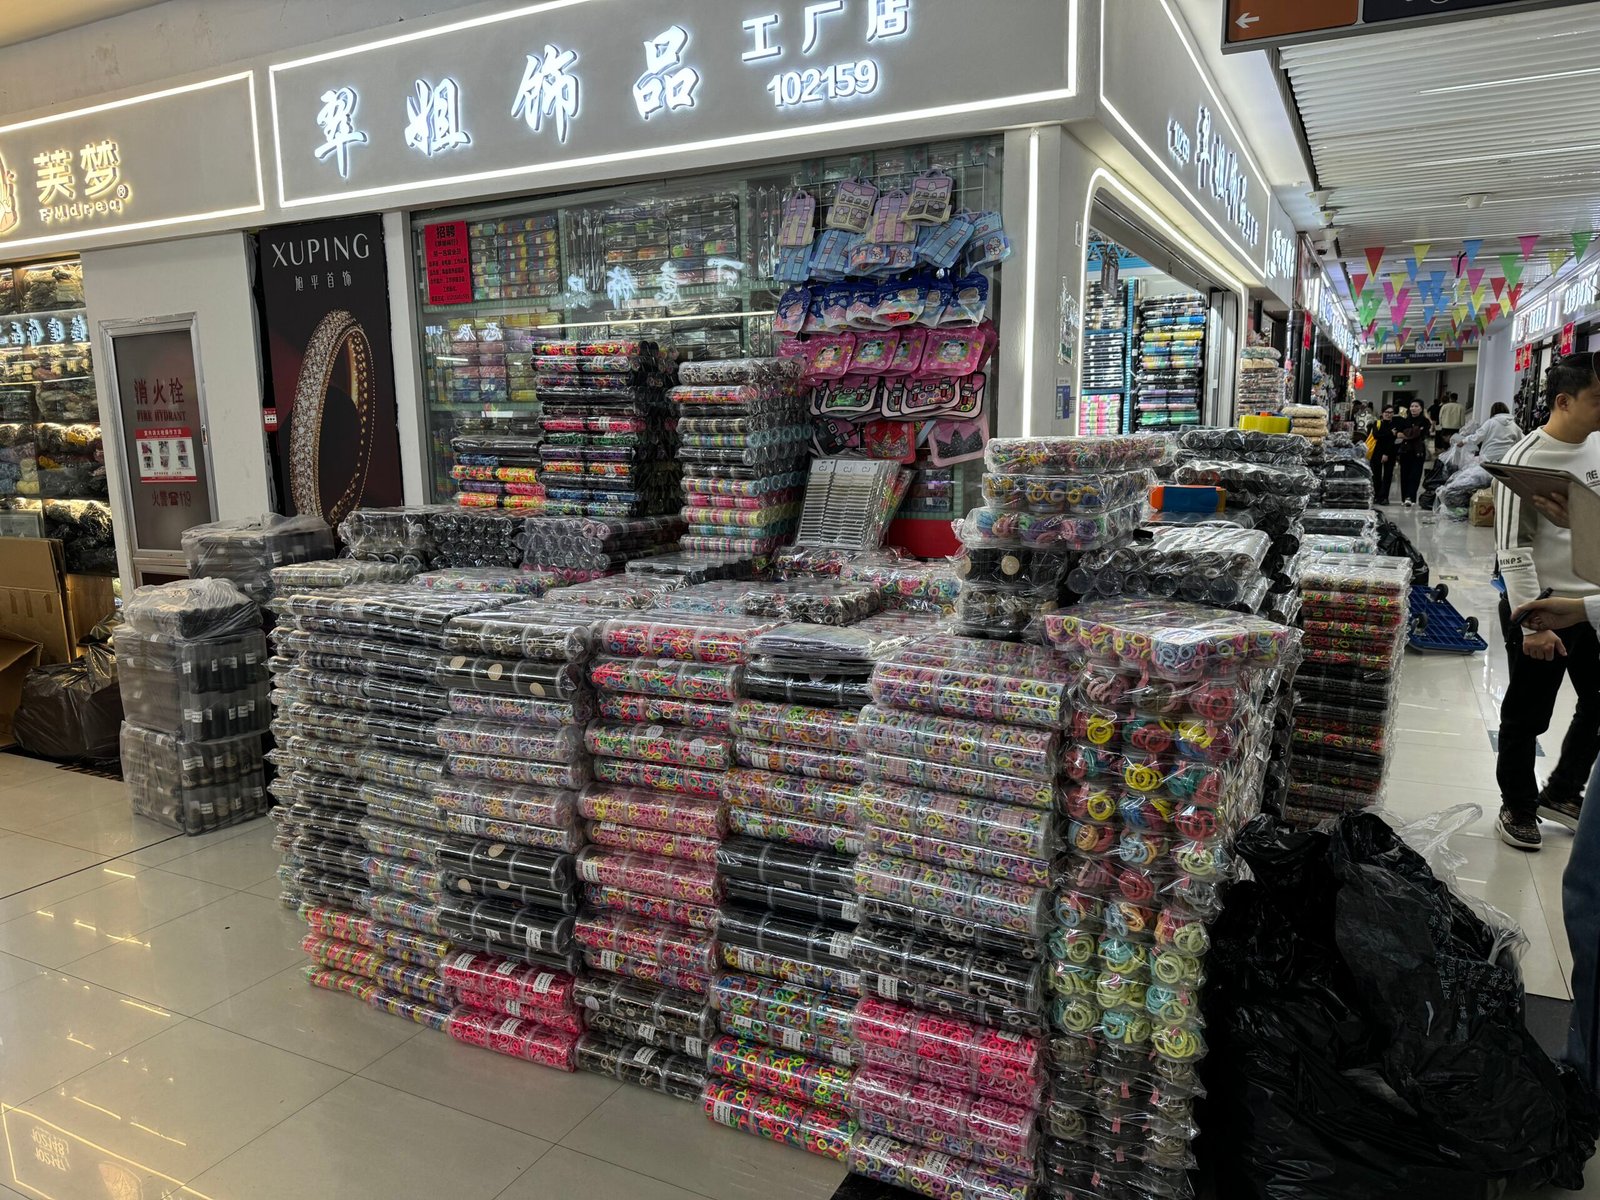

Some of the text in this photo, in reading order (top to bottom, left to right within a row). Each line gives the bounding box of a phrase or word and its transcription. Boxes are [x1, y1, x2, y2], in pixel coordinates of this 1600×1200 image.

[767, 59, 878, 107] 102159
[33, 140, 119, 203] 芙梦
[271, 233, 370, 268] XUPING
[133, 377, 185, 405] 消火栓
